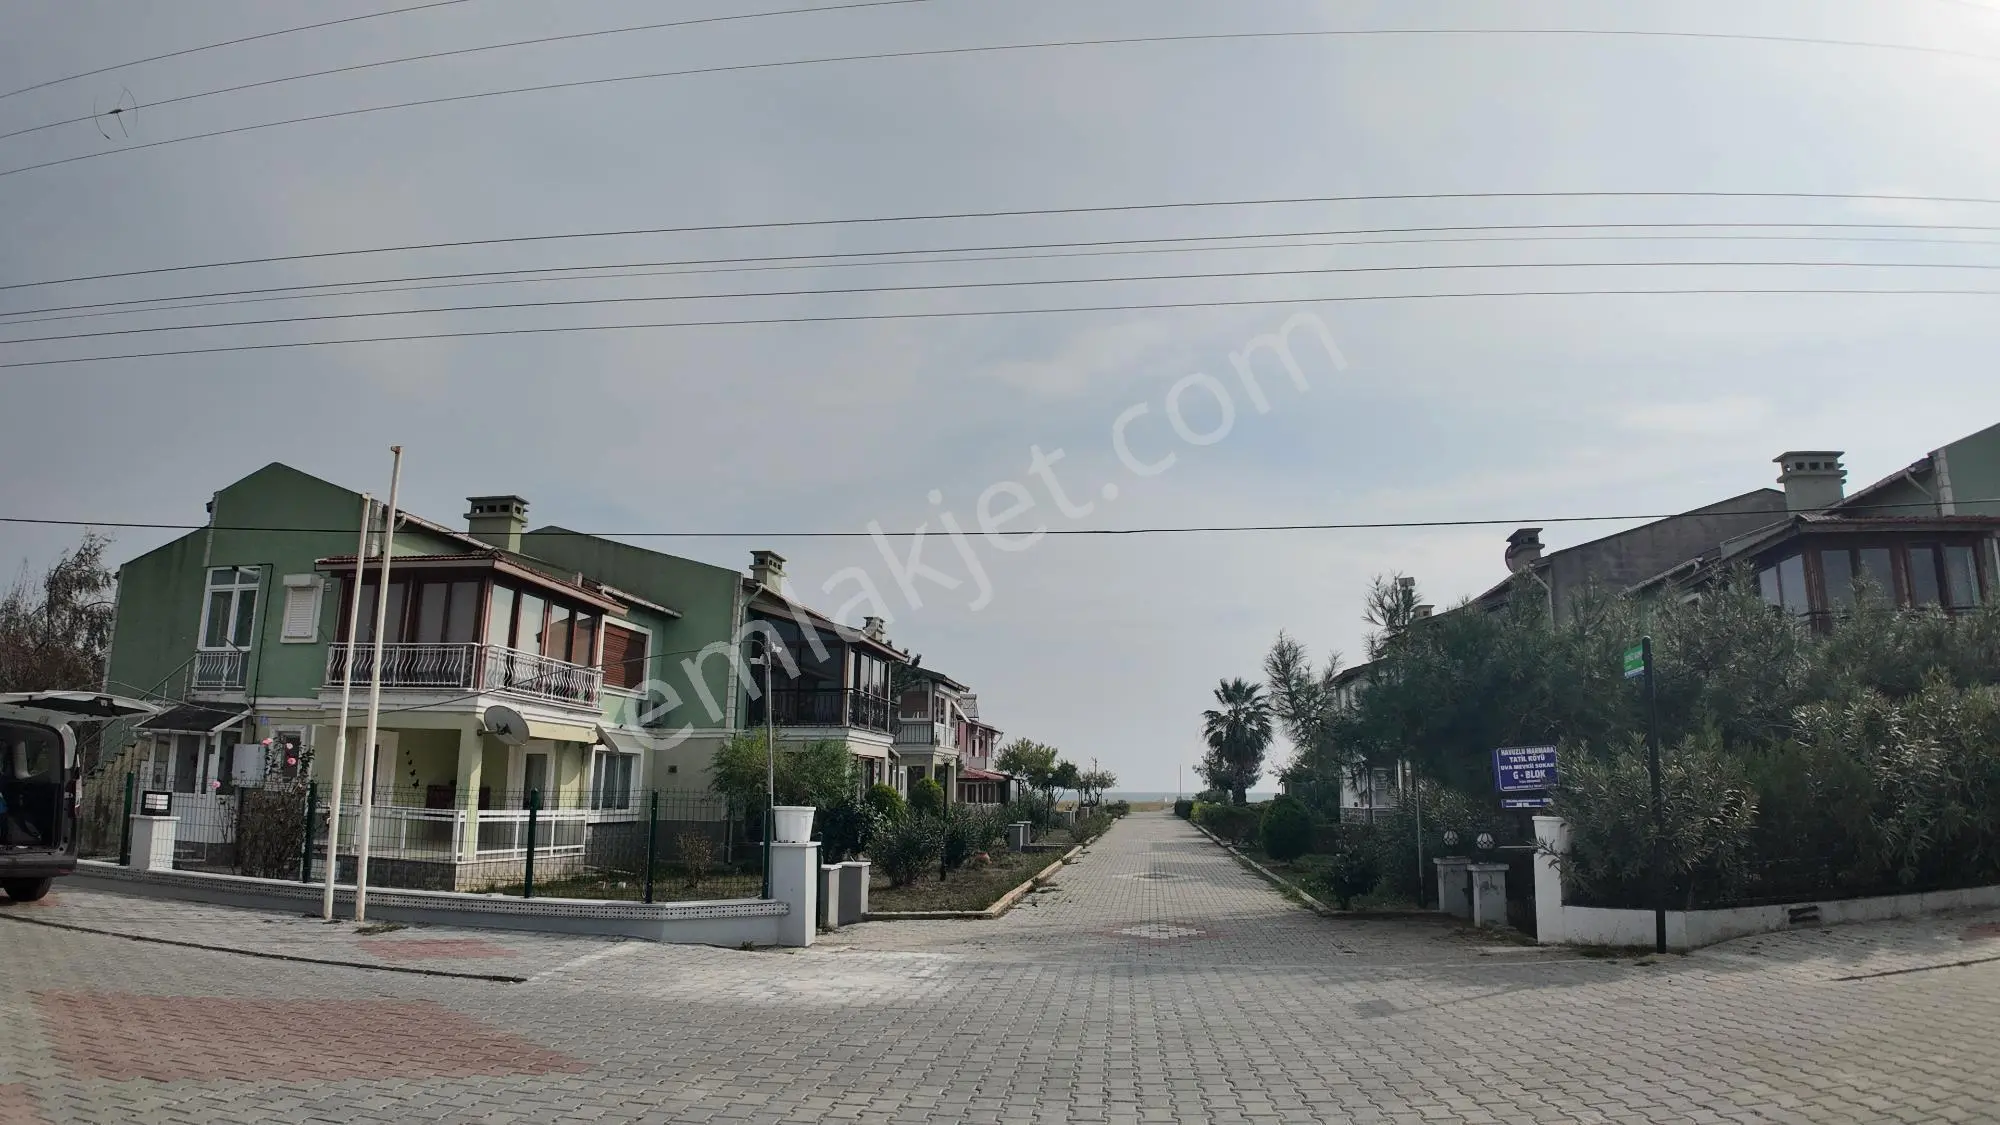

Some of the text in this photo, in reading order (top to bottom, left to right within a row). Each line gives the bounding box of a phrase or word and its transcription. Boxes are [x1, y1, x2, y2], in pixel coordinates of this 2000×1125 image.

[1526, 747, 1555, 755] MARMARA
[1509, 755, 1527, 763] TATİL
[1525, 770, 1546, 779] BLOK
